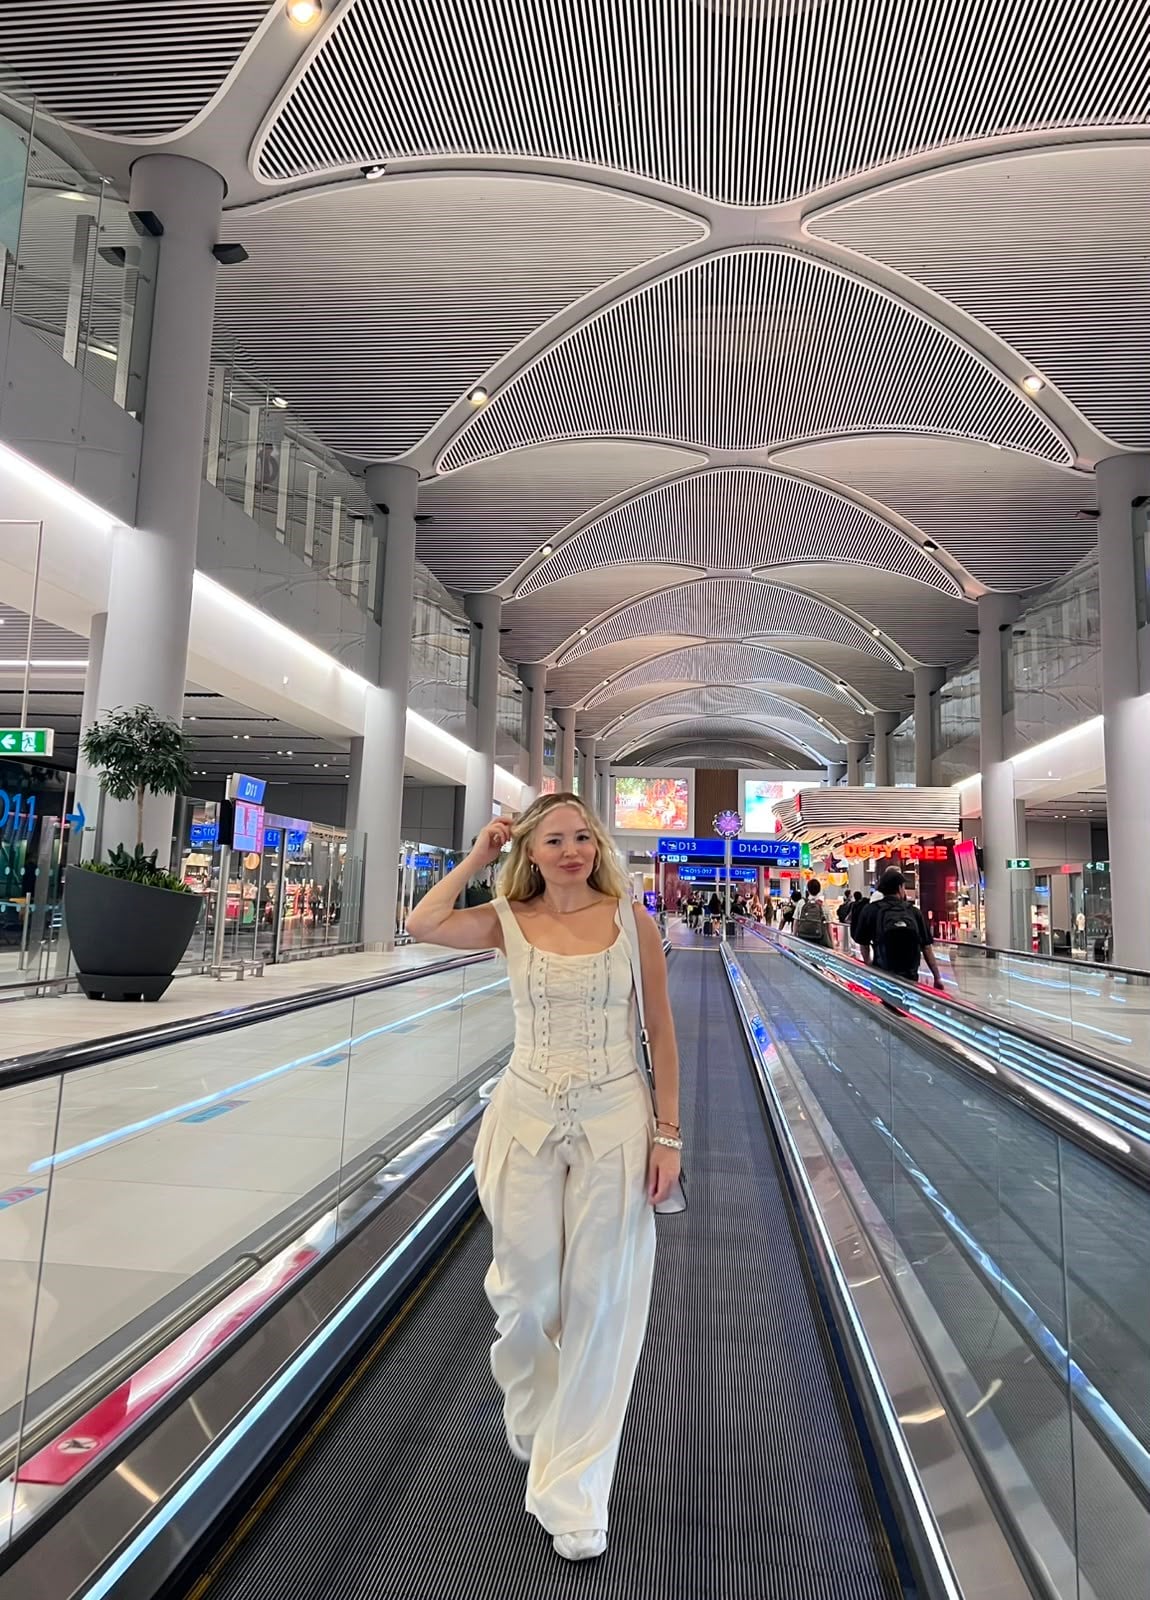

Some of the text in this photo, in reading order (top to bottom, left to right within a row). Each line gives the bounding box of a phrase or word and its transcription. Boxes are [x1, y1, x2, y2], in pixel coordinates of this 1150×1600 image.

[245, 782, 257, 797] D11
[678, 841, 697, 851] D13
[739, 843, 780, 854] D14-D17
[844, 843, 948, 860] DUTY FREE
